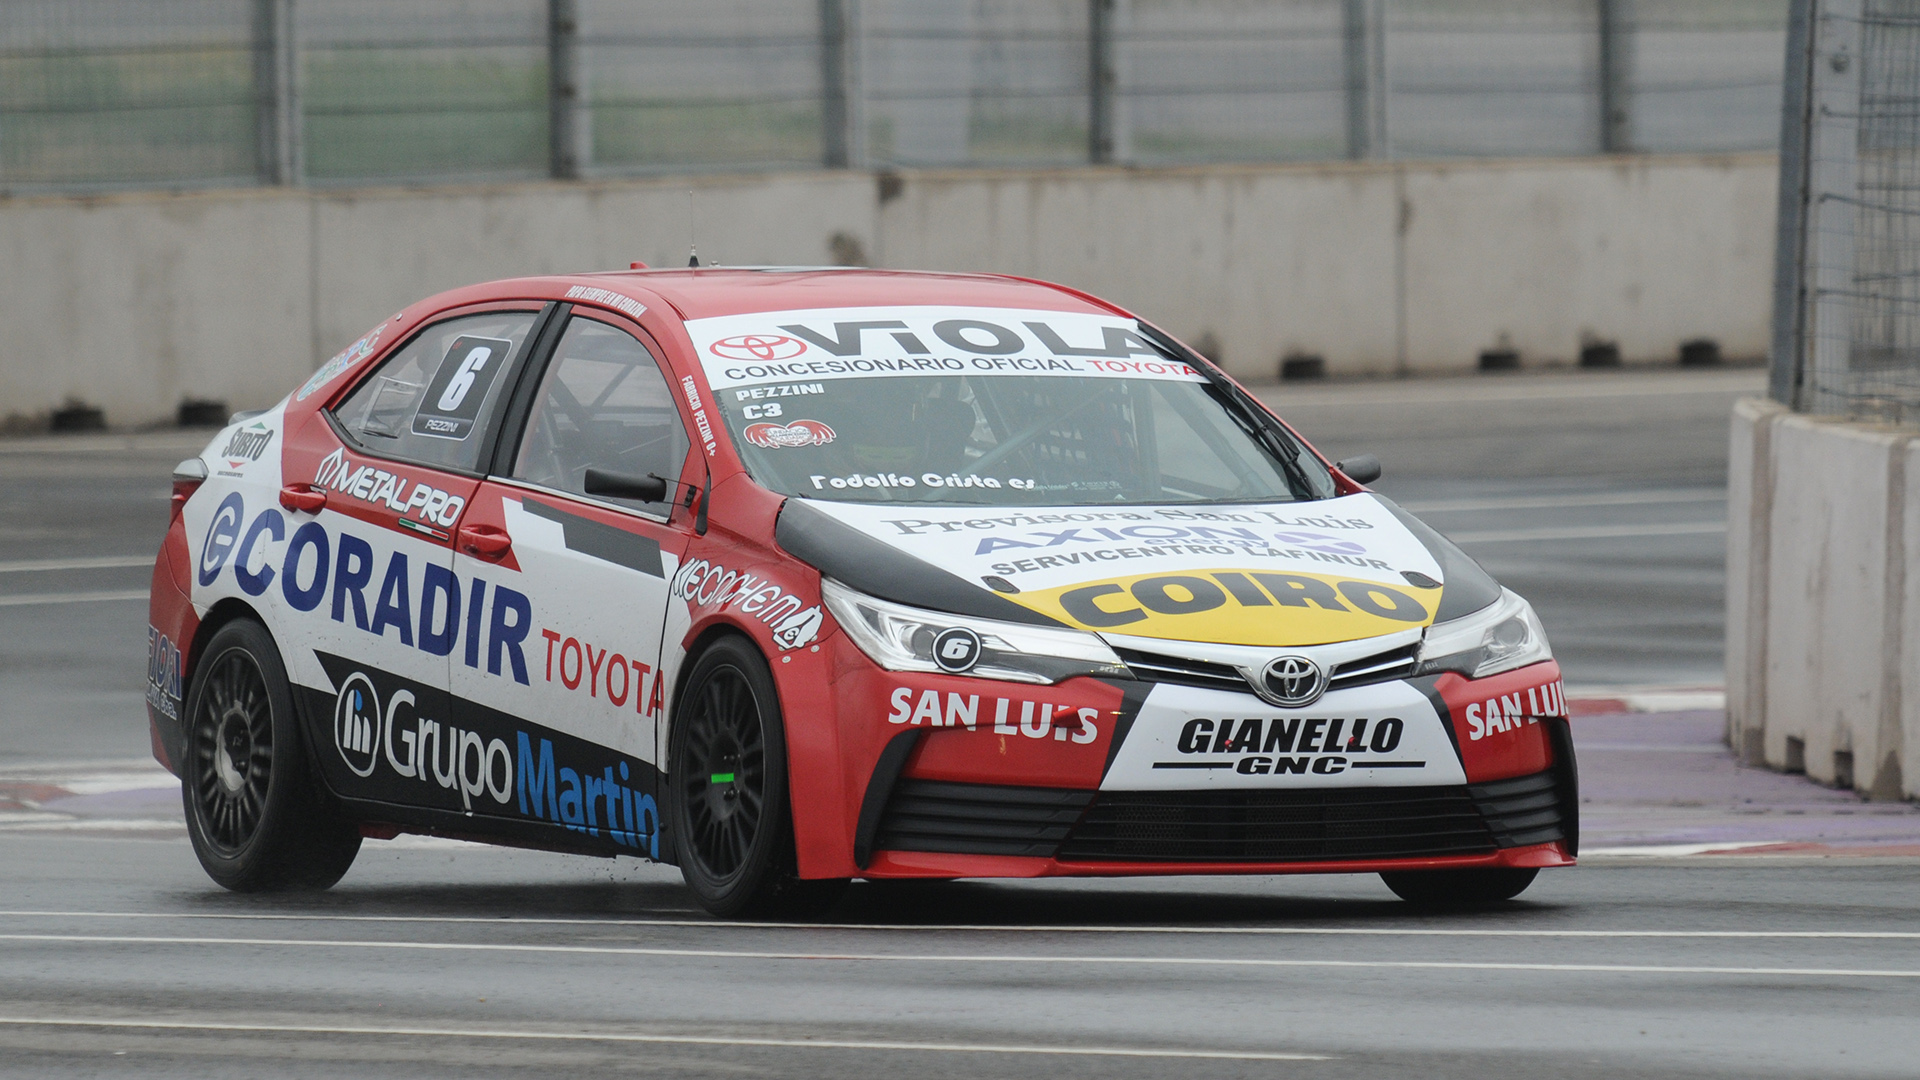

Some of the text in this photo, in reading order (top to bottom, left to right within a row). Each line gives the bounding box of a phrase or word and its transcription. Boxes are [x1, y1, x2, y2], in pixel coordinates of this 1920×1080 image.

[437, 346, 492, 412] 6
[724, 358, 1203, 381] CONCESIONARIO OFICIAL TOYOTA
[681, 374, 702, 411] FABRICIO
[693, 409, 714, 444] PEZZINI
[735, 383, 825, 402] PEZZINI
[424, 419, 459, 433] PEZZINI
[742, 402, 783, 421] C3
[221, 426, 275, 461] SUBITO
[335, 459, 465, 528] METALPRO
[879, 507, 1376, 536] Previsora San Luis
[974, 524, 1266, 557] AXION
[1143, 536, 1271, 549] energy
[990, 544, 1396, 576] SERVICENTRO LAFINUR
[234, 508, 532, 687] CORADIR
[1058, 571, 1429, 628] COIRO
[941, 637, 973, 660] 6
[541, 627, 666, 724] TOYOTA
[888, 686, 1099, 745] SAN LUIS
[1465, 680, 1570, 742] SAN LUI
[1176, 716, 1405, 755] GIANELLO
[384, 688, 660, 860] Grupo Martin
[1235, 755, 1349, 775] GNC
